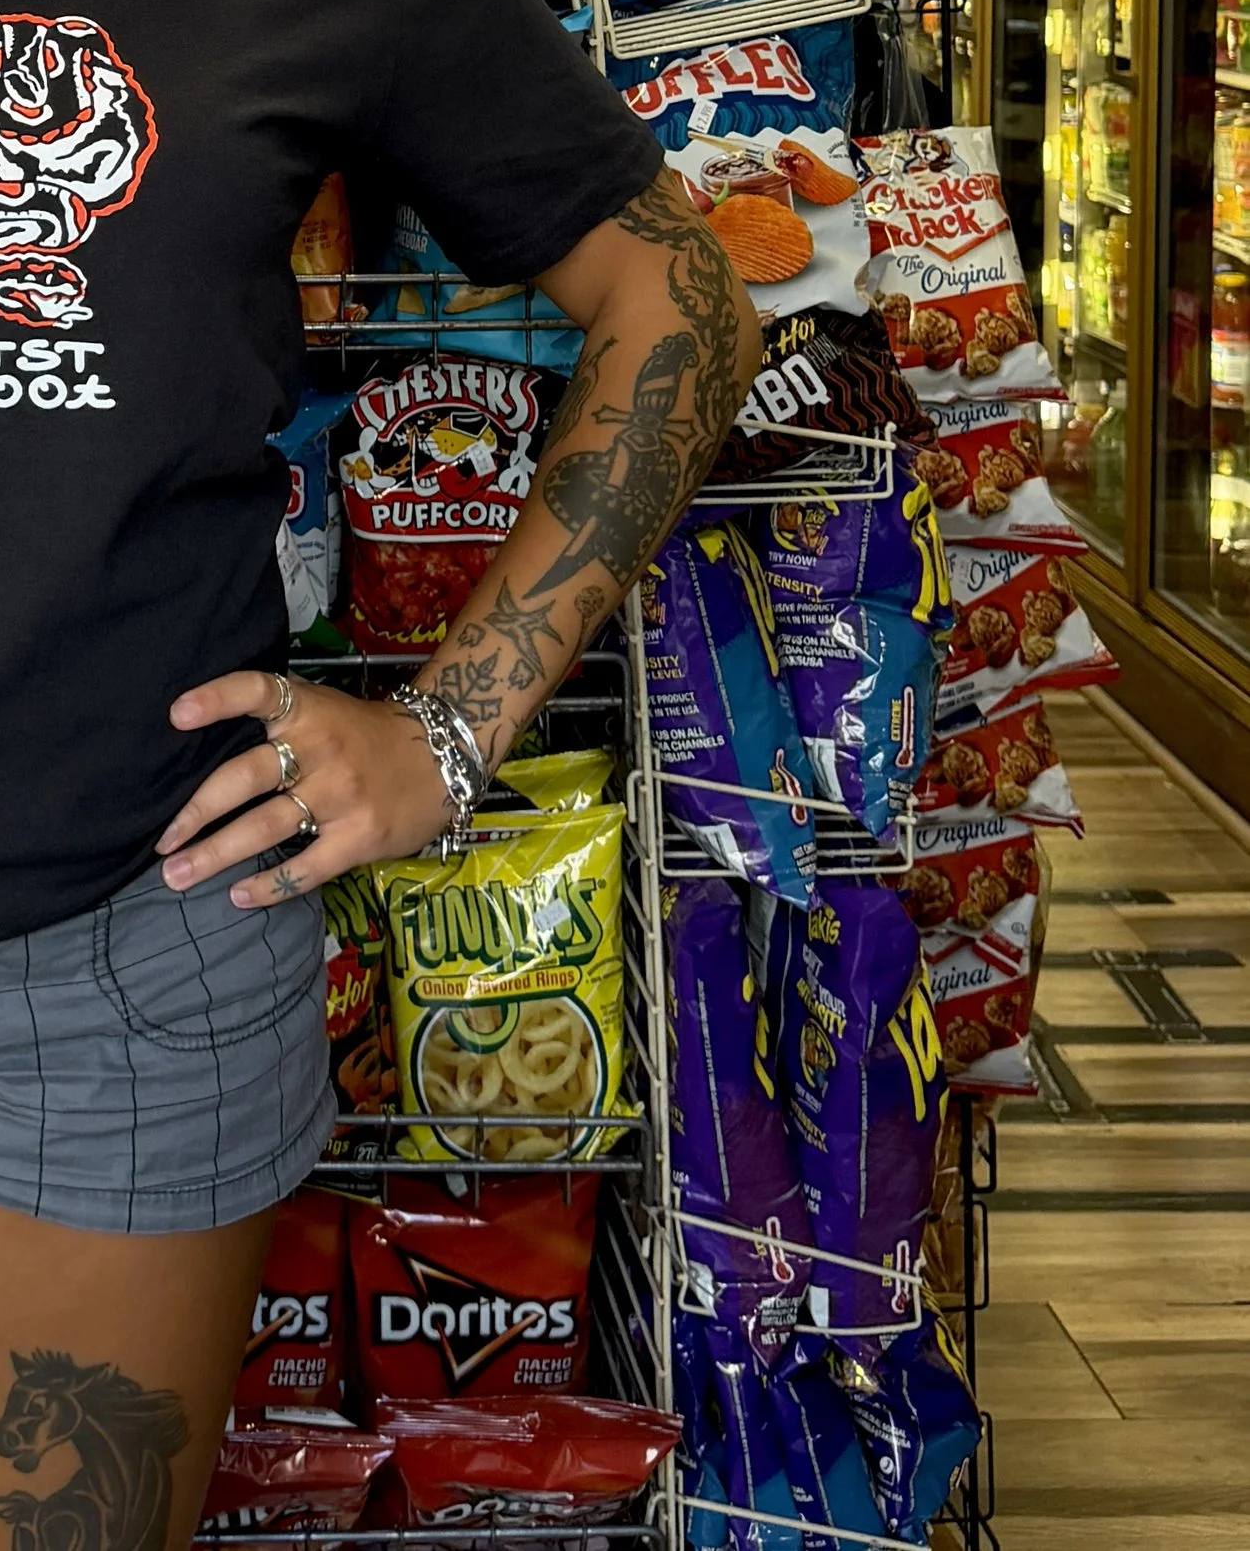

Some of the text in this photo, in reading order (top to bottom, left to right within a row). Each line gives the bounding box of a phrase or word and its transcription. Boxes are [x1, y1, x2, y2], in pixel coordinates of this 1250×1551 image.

[626, 41, 812, 115] UFFLES
[901, 205, 984, 248] Jack
[896, 255, 1007, 296] The Original
[358, 363, 531, 431] CHESTER'S
[785, 554, 817, 567] NOW!
[657, 691, 695, 704] PRODUCT
[664, 706, 682, 717] THE
[683, 704, 700, 715] USA
[672, 727, 686, 740] ON
[687, 725, 706, 738] ALL
[422, 978, 465, 997] Onion
[535, 967, 576, 989] Rings
[930, 962, 993, 1003] iginal
[380, 1296, 575, 1343] Doritos
[273, 1357, 327, 1373] NACHO
[518, 1357, 572, 1373] NACHO
[268, 1371, 326, 1387] CHEESE
[513, 1370, 571, 1386] CHEESE
